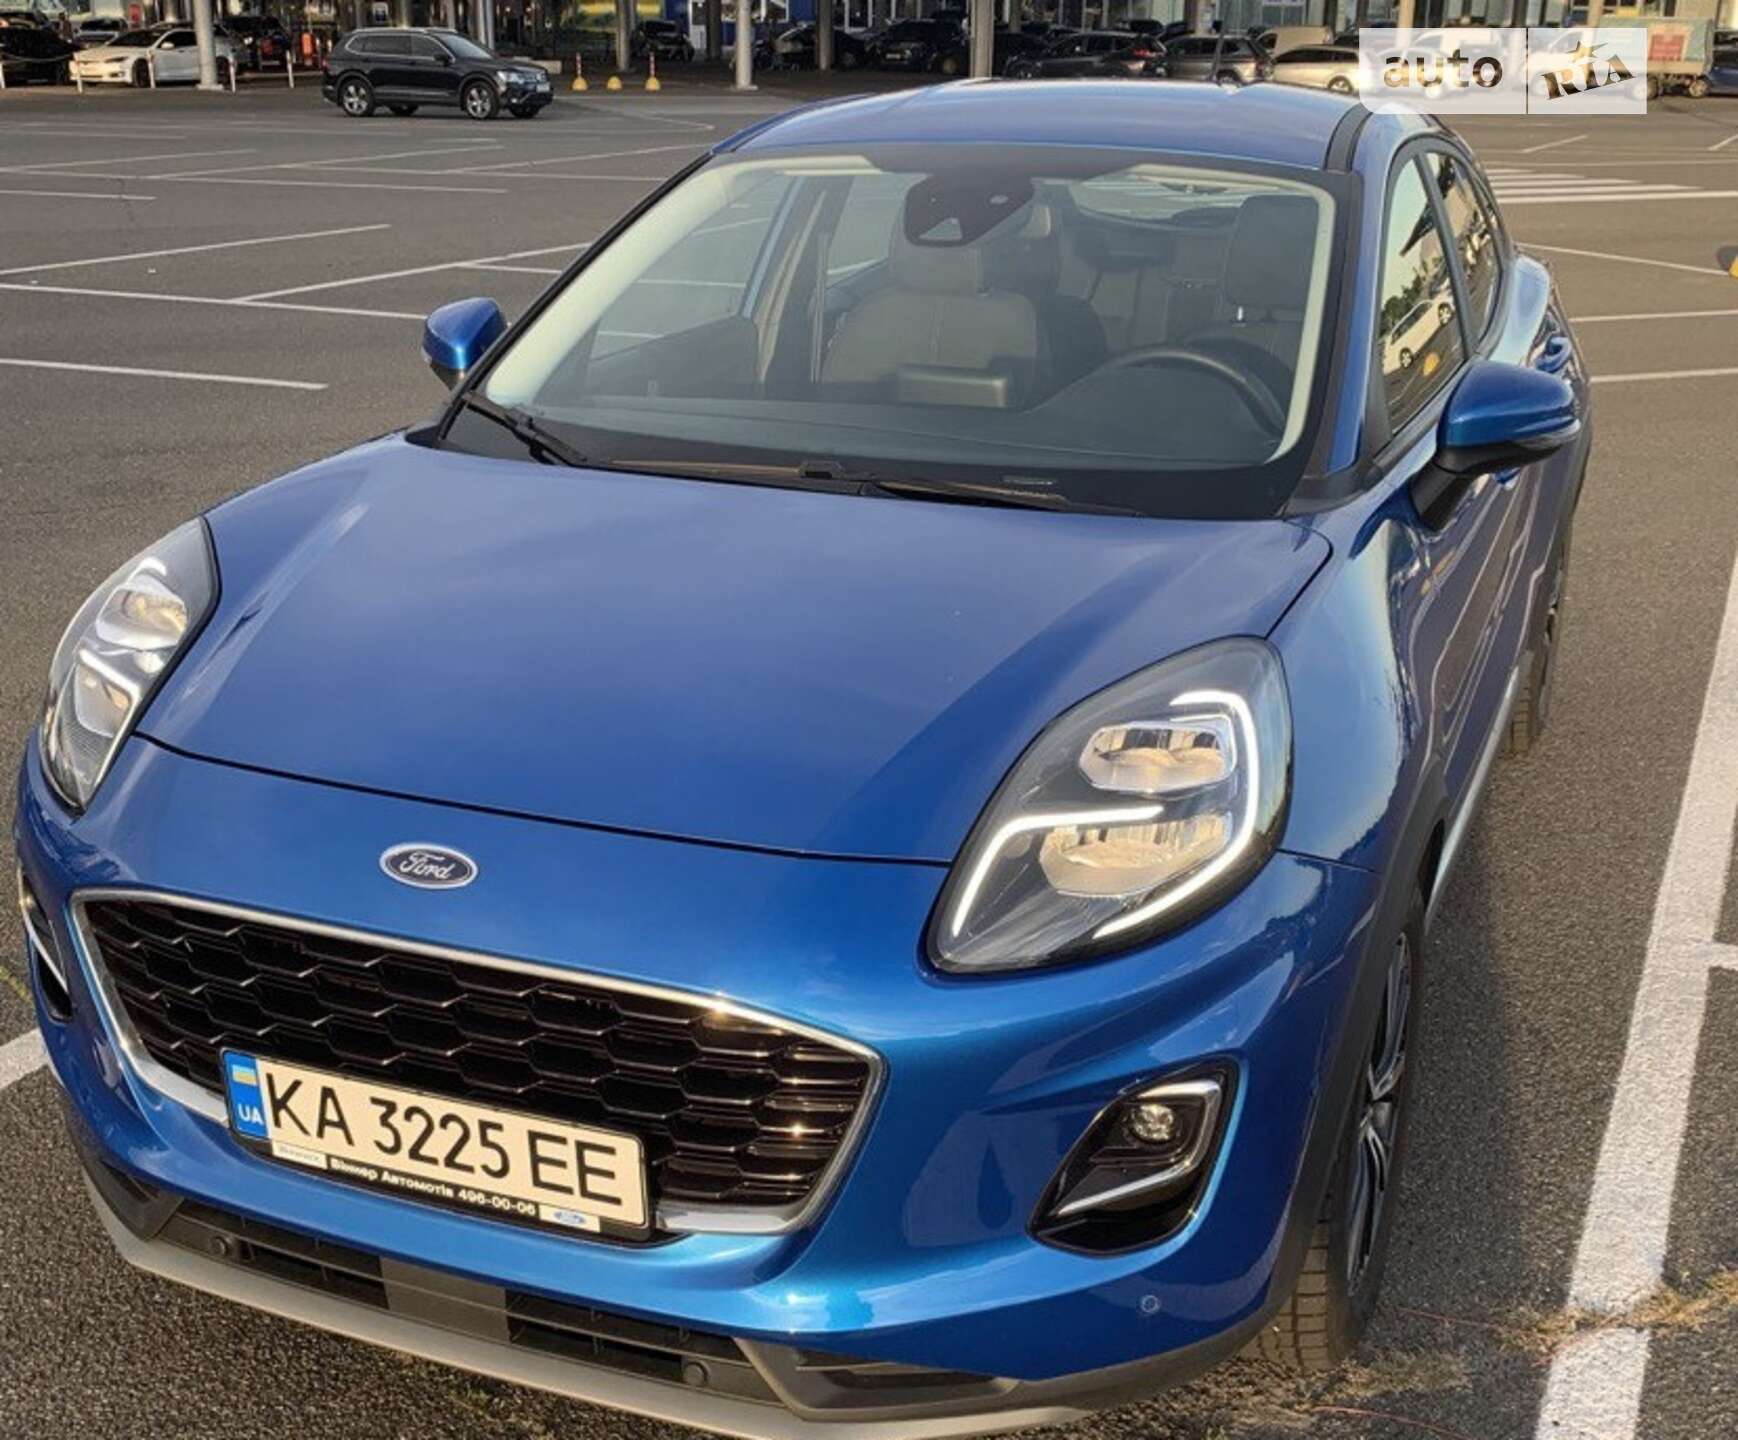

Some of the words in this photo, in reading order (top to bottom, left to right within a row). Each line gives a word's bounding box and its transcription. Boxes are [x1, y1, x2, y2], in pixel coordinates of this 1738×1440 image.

[399, 850, 456, 880] Ford
[238, 1103, 263, 1125] UA
[266, 1073, 355, 1147] KA
[370, 1096, 510, 1179] 3225
[527, 1130, 622, 1206] EE
